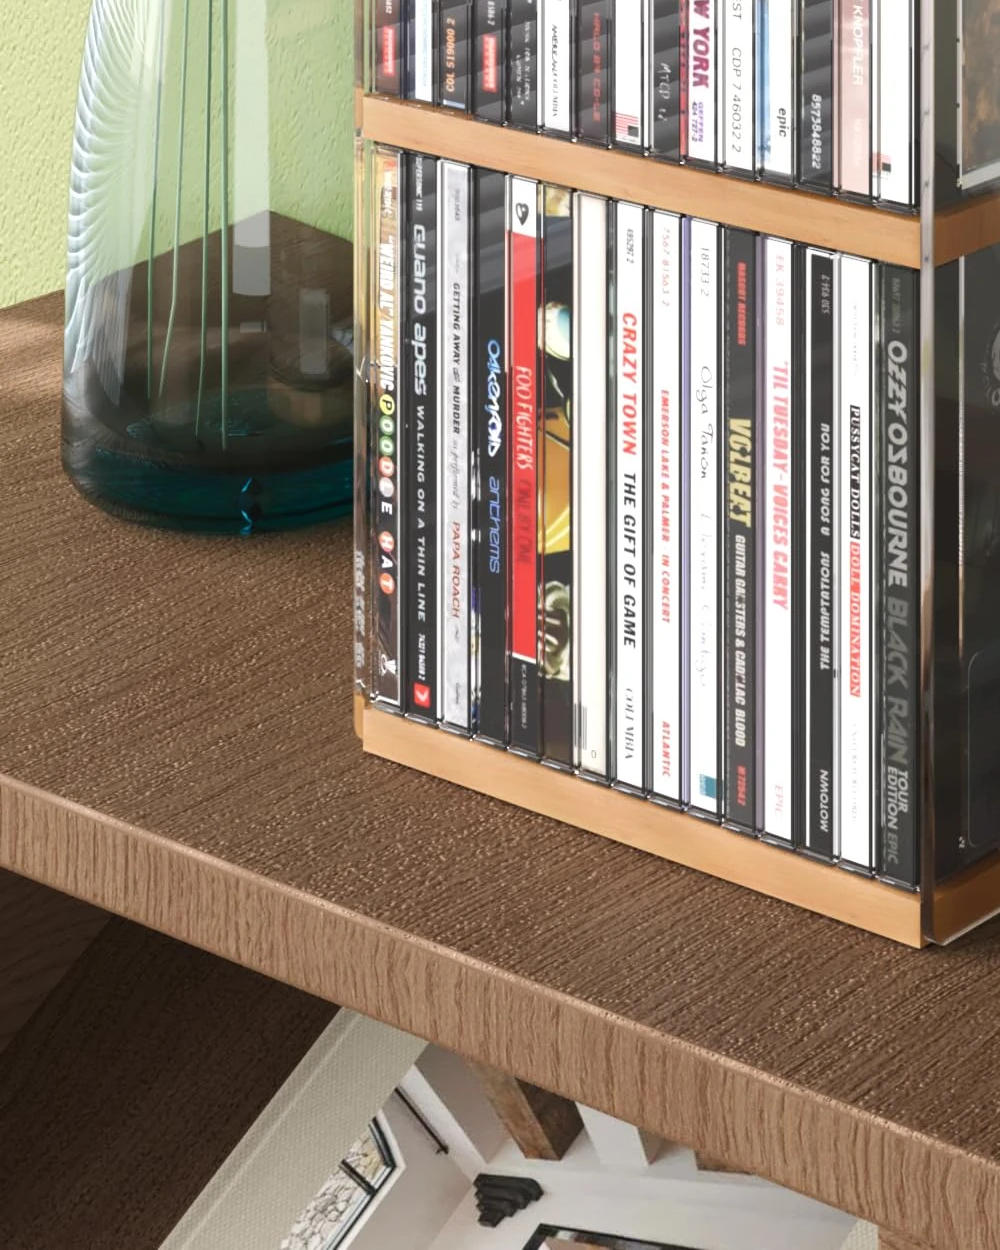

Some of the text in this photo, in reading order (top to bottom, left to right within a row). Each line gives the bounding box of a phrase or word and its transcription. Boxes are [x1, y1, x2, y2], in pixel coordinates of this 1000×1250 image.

[693, 25, 711, 90] YORK
[731, 46, 742, 77] CDP
[851, 4, 863, 86] KNOPFLER
[447, 72, 455, 92] COL
[731, 81, 742, 91] 7
[731, 93, 742, 141] 46032
[775, 106, 789, 138] epic
[731, 143, 742, 153] 2
[452, 282, 461, 330] GETTING
[380, 318, 394, 391] YANKOVIC
[452, 333, 461, 366] AWAY
[452, 385, 461, 435] MURDER
[695, 365, 714, 415] Olga
[516, 365, 534, 471] FOO FIGHTERS
[661, 389, 670, 447] EMERSON
[772, 392, 789, 473] TUESDAY
[416, 405, 426, 483] WALKING
[661, 449, 670, 479] LAKE
[621, 311, 638, 649] CRAZY TOWN THE GIFT OF GAME
[728, 417, 752, 528] VOLBEAT
[416, 488, 426, 512] ON
[416, 517, 426, 530] A
[661, 494, 670, 543] PALMER
[772, 483, 789, 546] VOICES
[451, 521, 461, 562] PAPA
[489, 476, 502, 575] anthems
[850, 405, 860, 695] PUSSYCAT DOLLS DOLL DOMINATION
[416, 535, 426, 577] THIN
[661, 554, 670, 567] IN
[734, 534, 746, 577] GUITAR
[887, 339, 908, 765] OZZY OSBOURNE BLACK RAIN
[416, 581, 426, 623] LINE
[451, 565, 461, 619] ROACH
[661, 570, 670, 624] CONCERT
[772, 550, 789, 610] CARRY
[735, 638, 746, 649] &
[819, 422, 830, 833] MOTOWN THE TEMPTATIONS A SONG FOR YOU
[661, 720, 671, 778] ATLANTIC
[734, 708, 746, 748] BLOOD
[774, 784, 785, 818] EPIC
[887, 765, 899, 865] EDITION EPIC
[898, 769, 909, 813] TOUR
